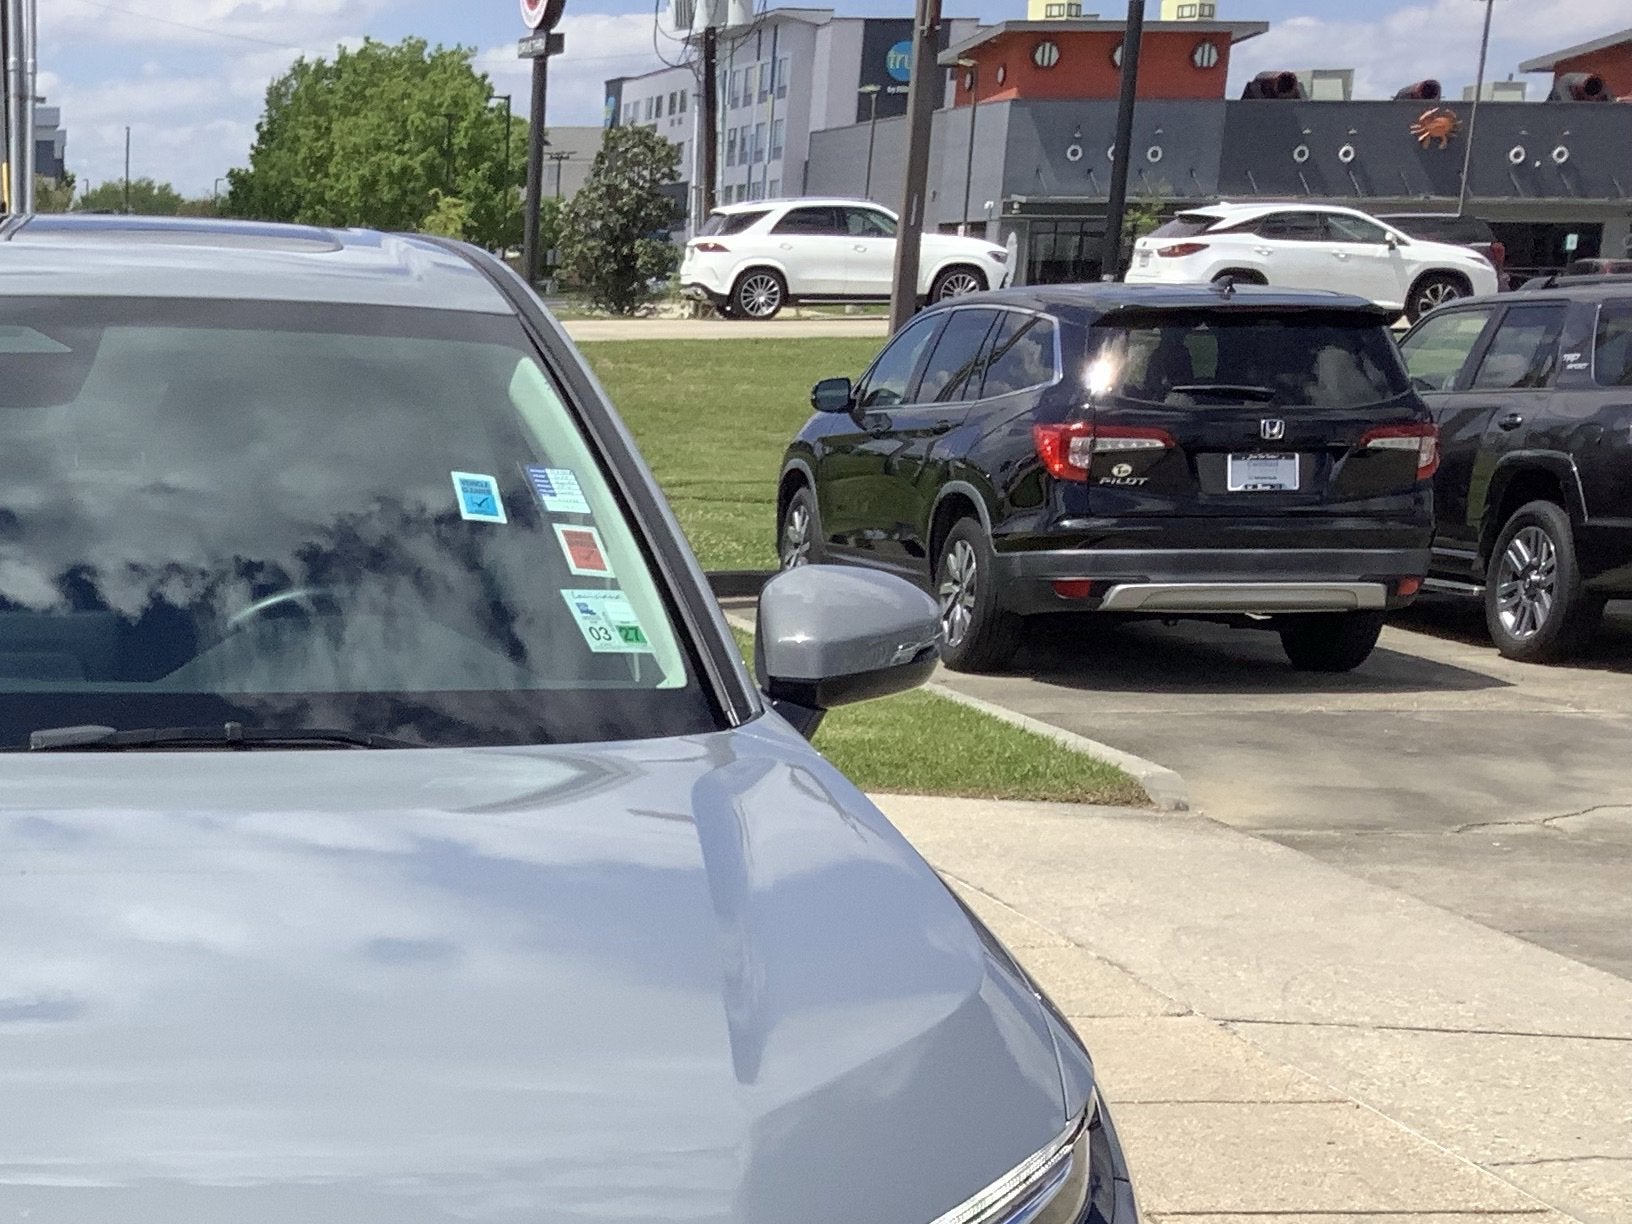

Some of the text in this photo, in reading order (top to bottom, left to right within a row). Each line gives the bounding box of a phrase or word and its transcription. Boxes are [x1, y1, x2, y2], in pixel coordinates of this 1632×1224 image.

[1099, 476, 1149, 486] PILOT
[588, 625, 641, 641] 03 27
